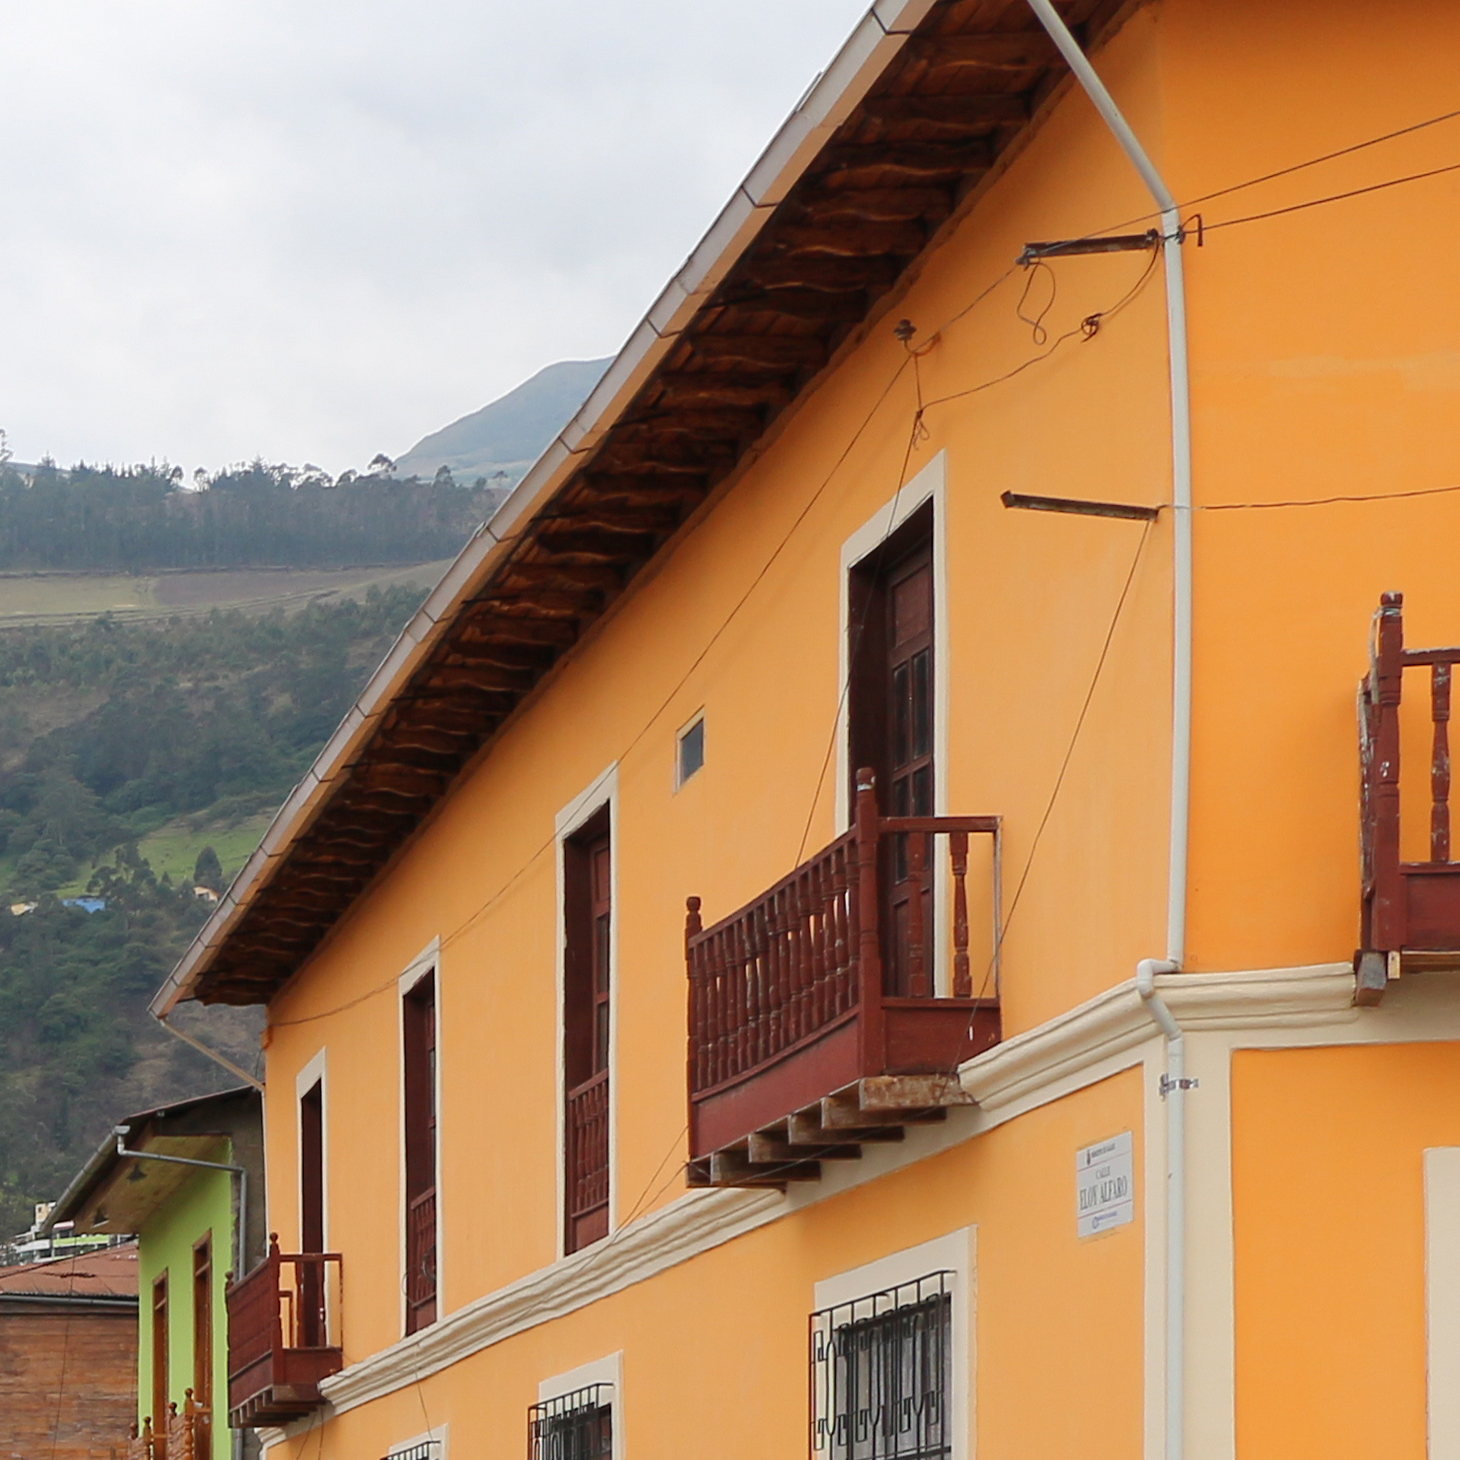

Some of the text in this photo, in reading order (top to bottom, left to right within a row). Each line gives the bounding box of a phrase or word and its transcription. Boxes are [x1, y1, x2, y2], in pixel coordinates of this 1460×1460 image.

[1095, 1166, 1110, 1179] CALLE
[1080, 1175, 1128, 1210] ELOY ALFARO
